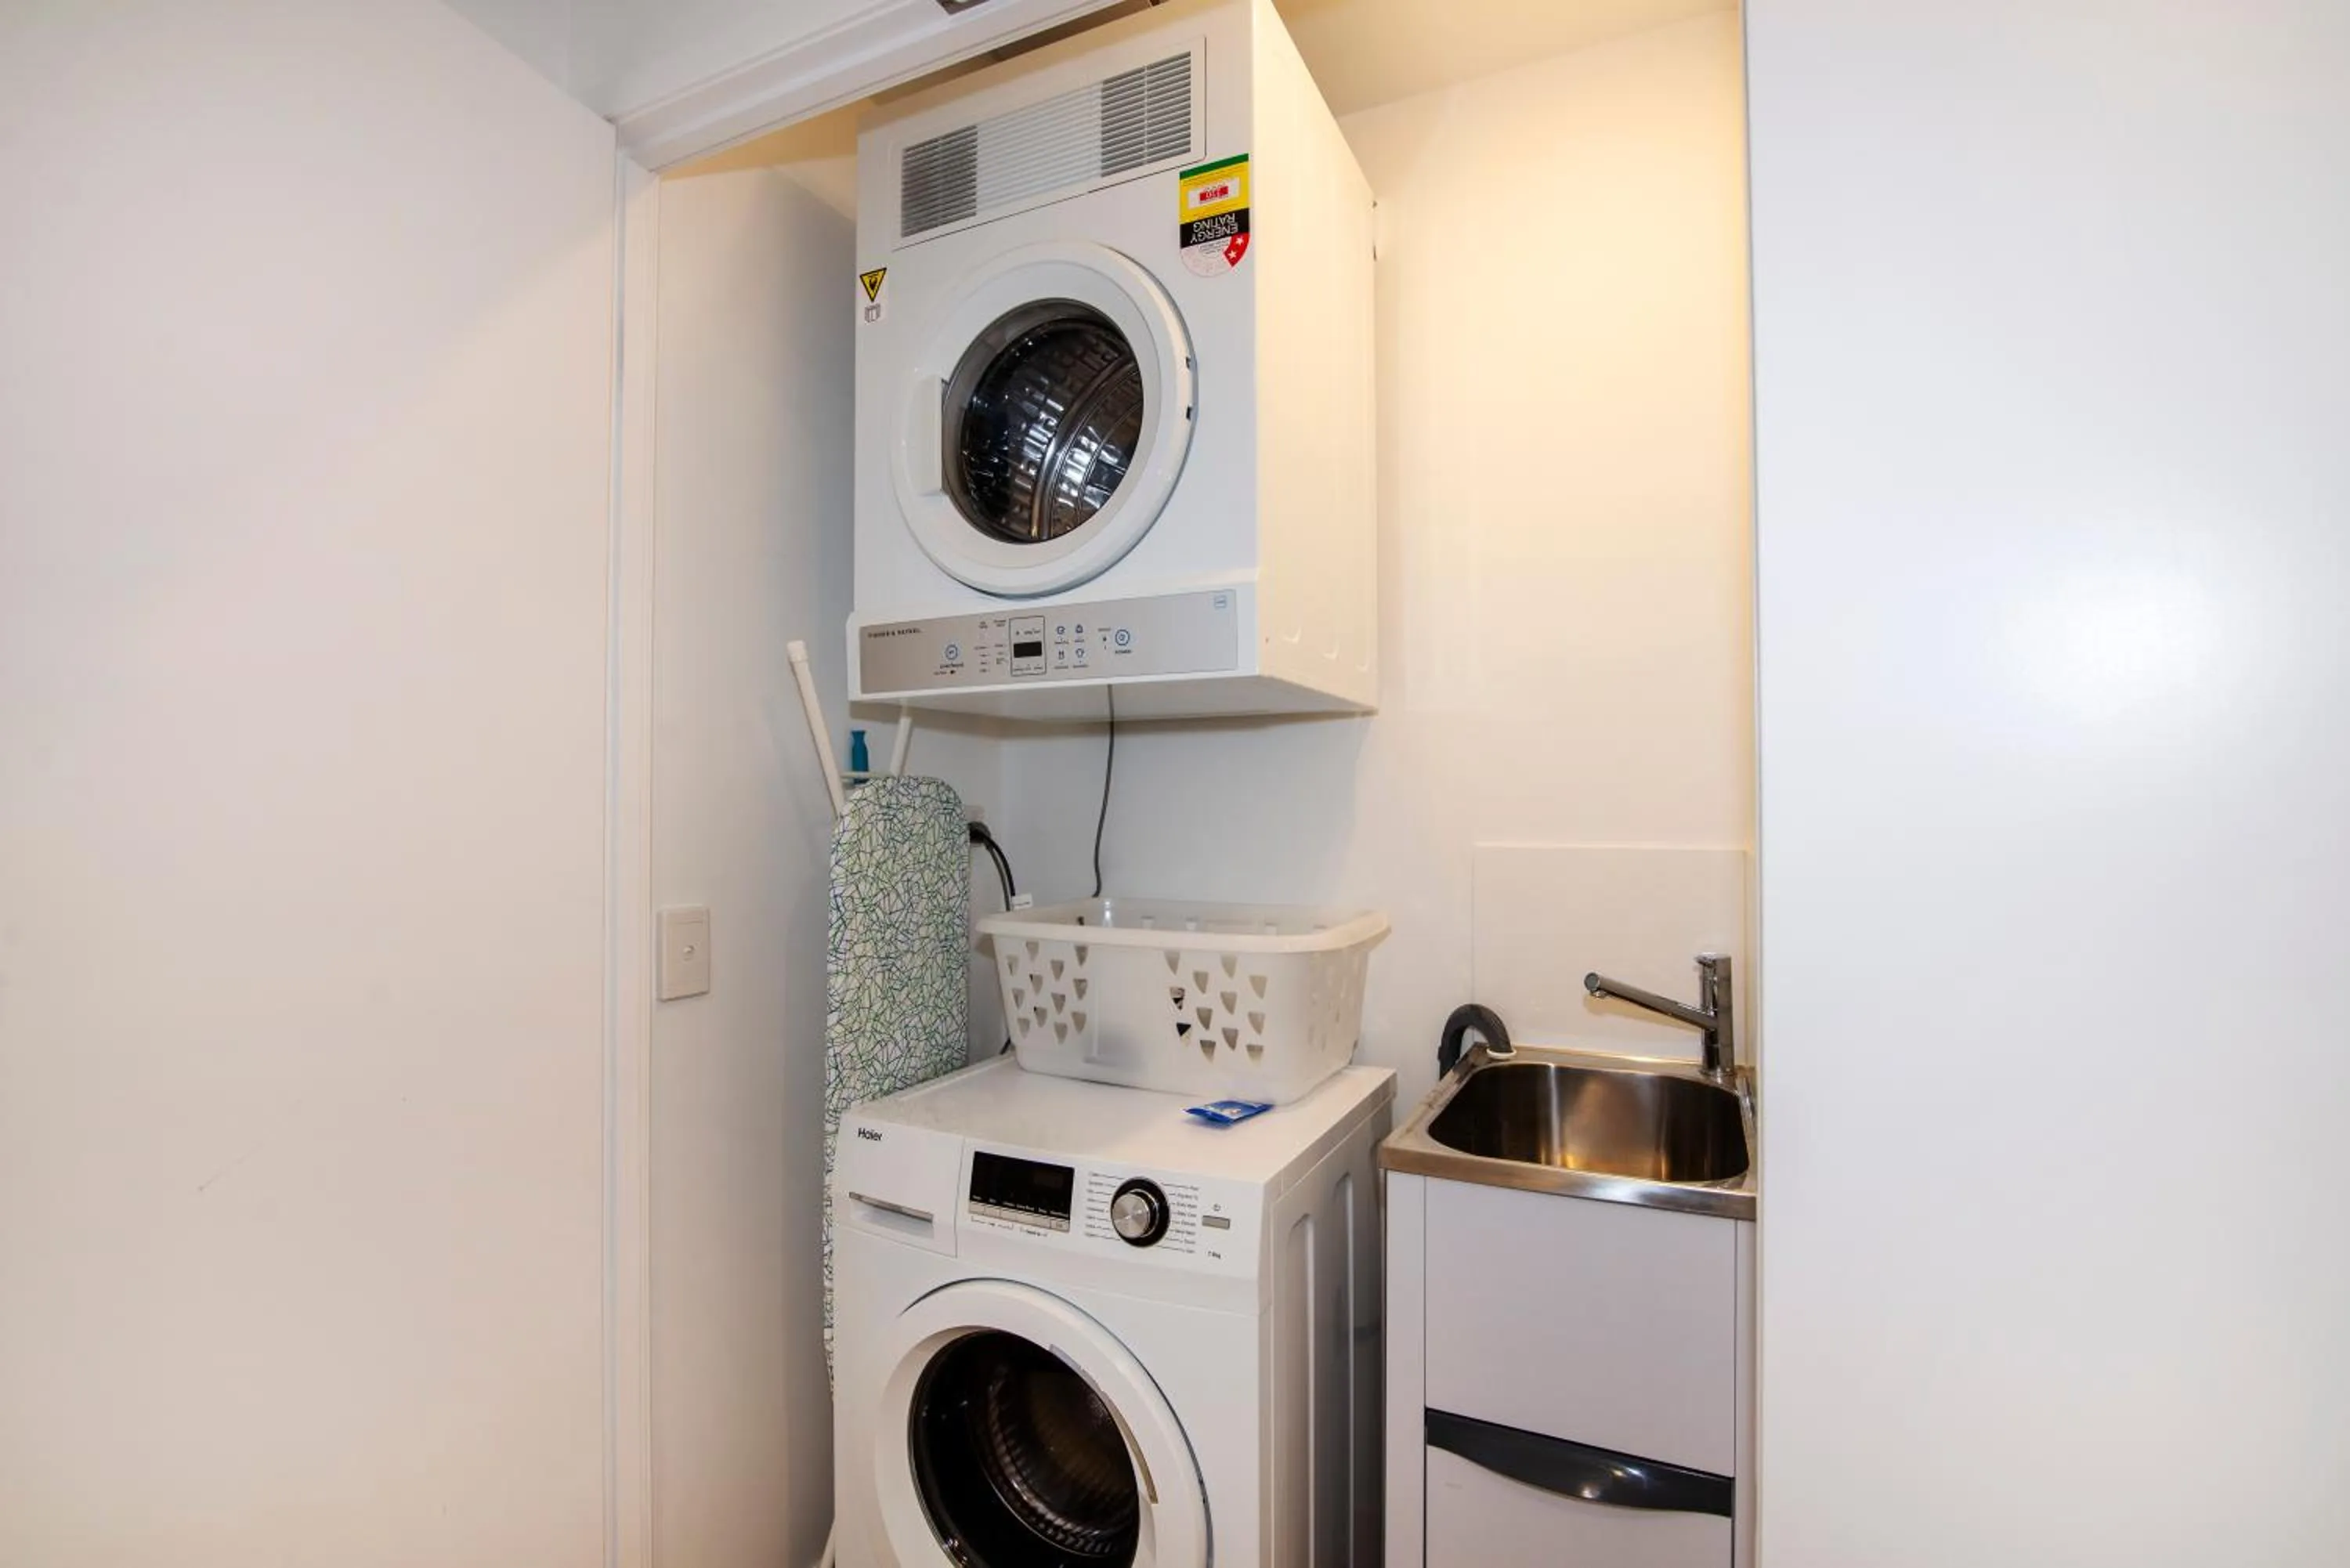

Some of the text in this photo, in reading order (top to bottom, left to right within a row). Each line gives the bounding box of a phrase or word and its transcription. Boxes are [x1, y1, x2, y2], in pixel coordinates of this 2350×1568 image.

[1190, 222, 1238, 244] ENERGY
[1193, 212, 1235, 233] RATING
[858, 1128, 882, 1140] Haier
